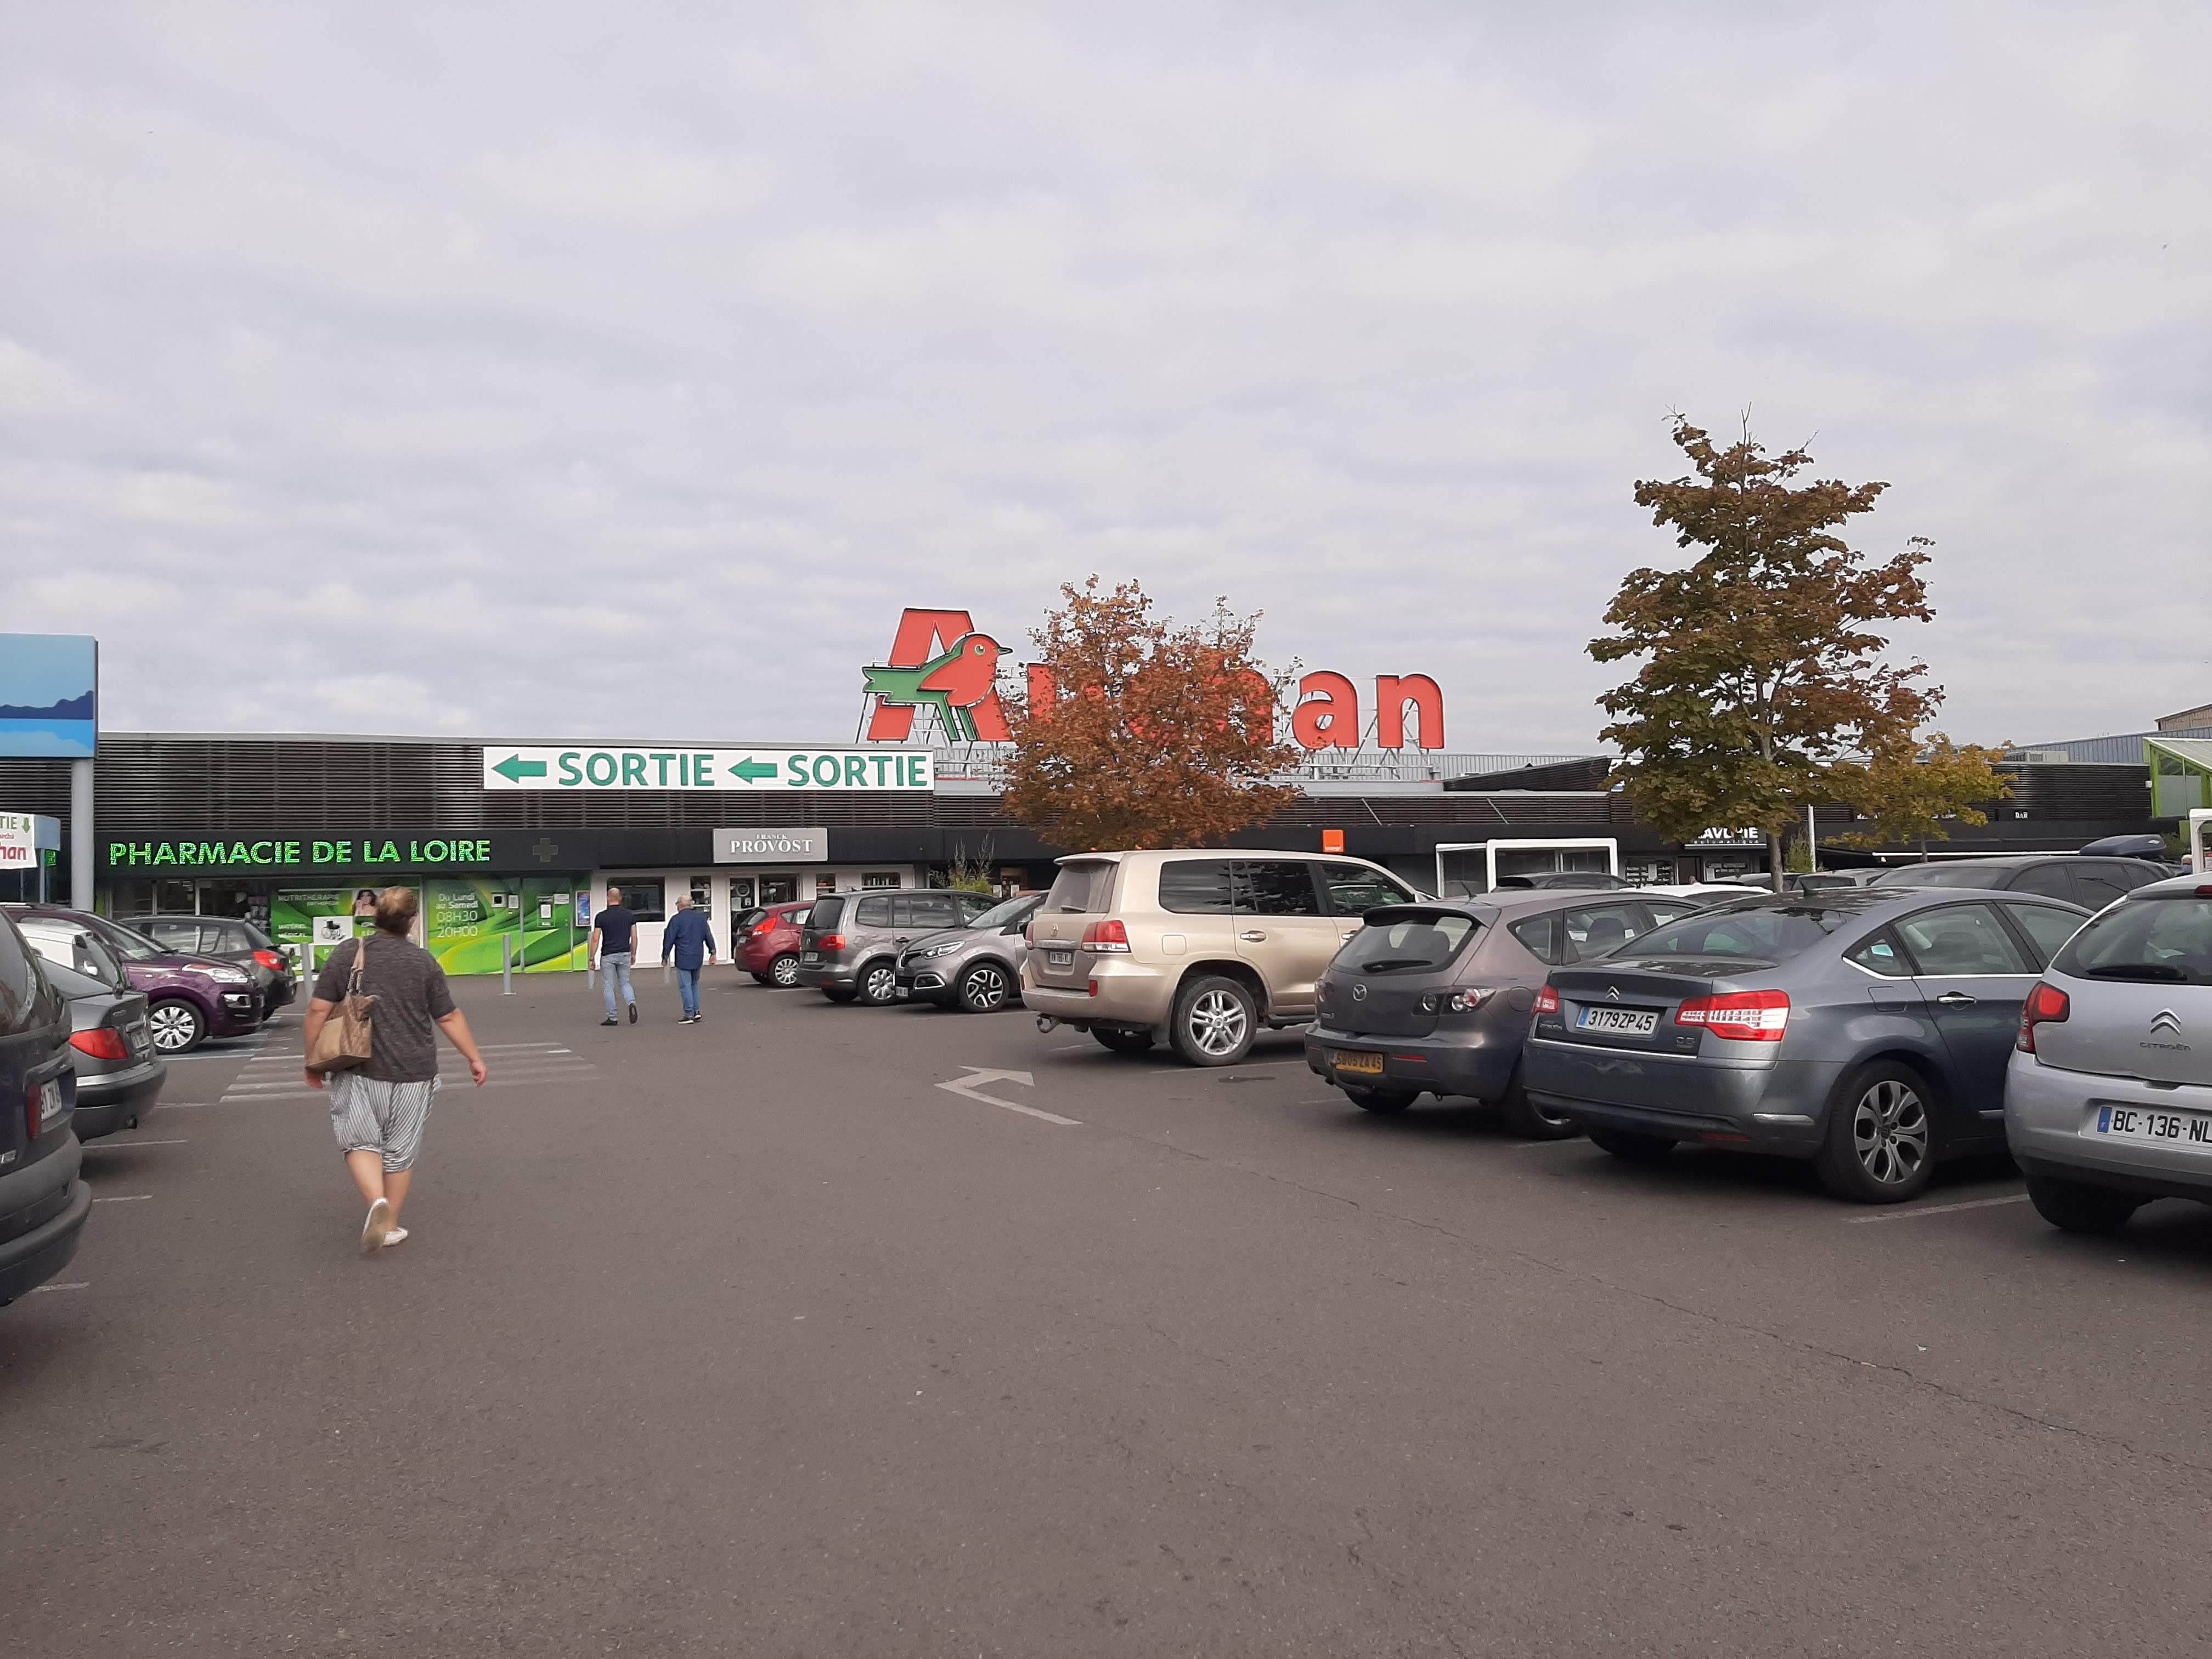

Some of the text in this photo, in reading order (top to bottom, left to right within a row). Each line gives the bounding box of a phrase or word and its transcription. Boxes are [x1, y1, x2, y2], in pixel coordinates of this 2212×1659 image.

[558, 752, 928, 787] SORTIE SORTIE
[110, 839, 490, 865] PHARMACIE DE LA LOIRE
[730, 839, 813, 853] PROVOST
[448, 901, 478, 909] Samedi
[436, 910, 478, 922] 08H30
[437, 926, 478, 938] 20H00
[1588, 1010, 1654, 1031] 3179ZP45
